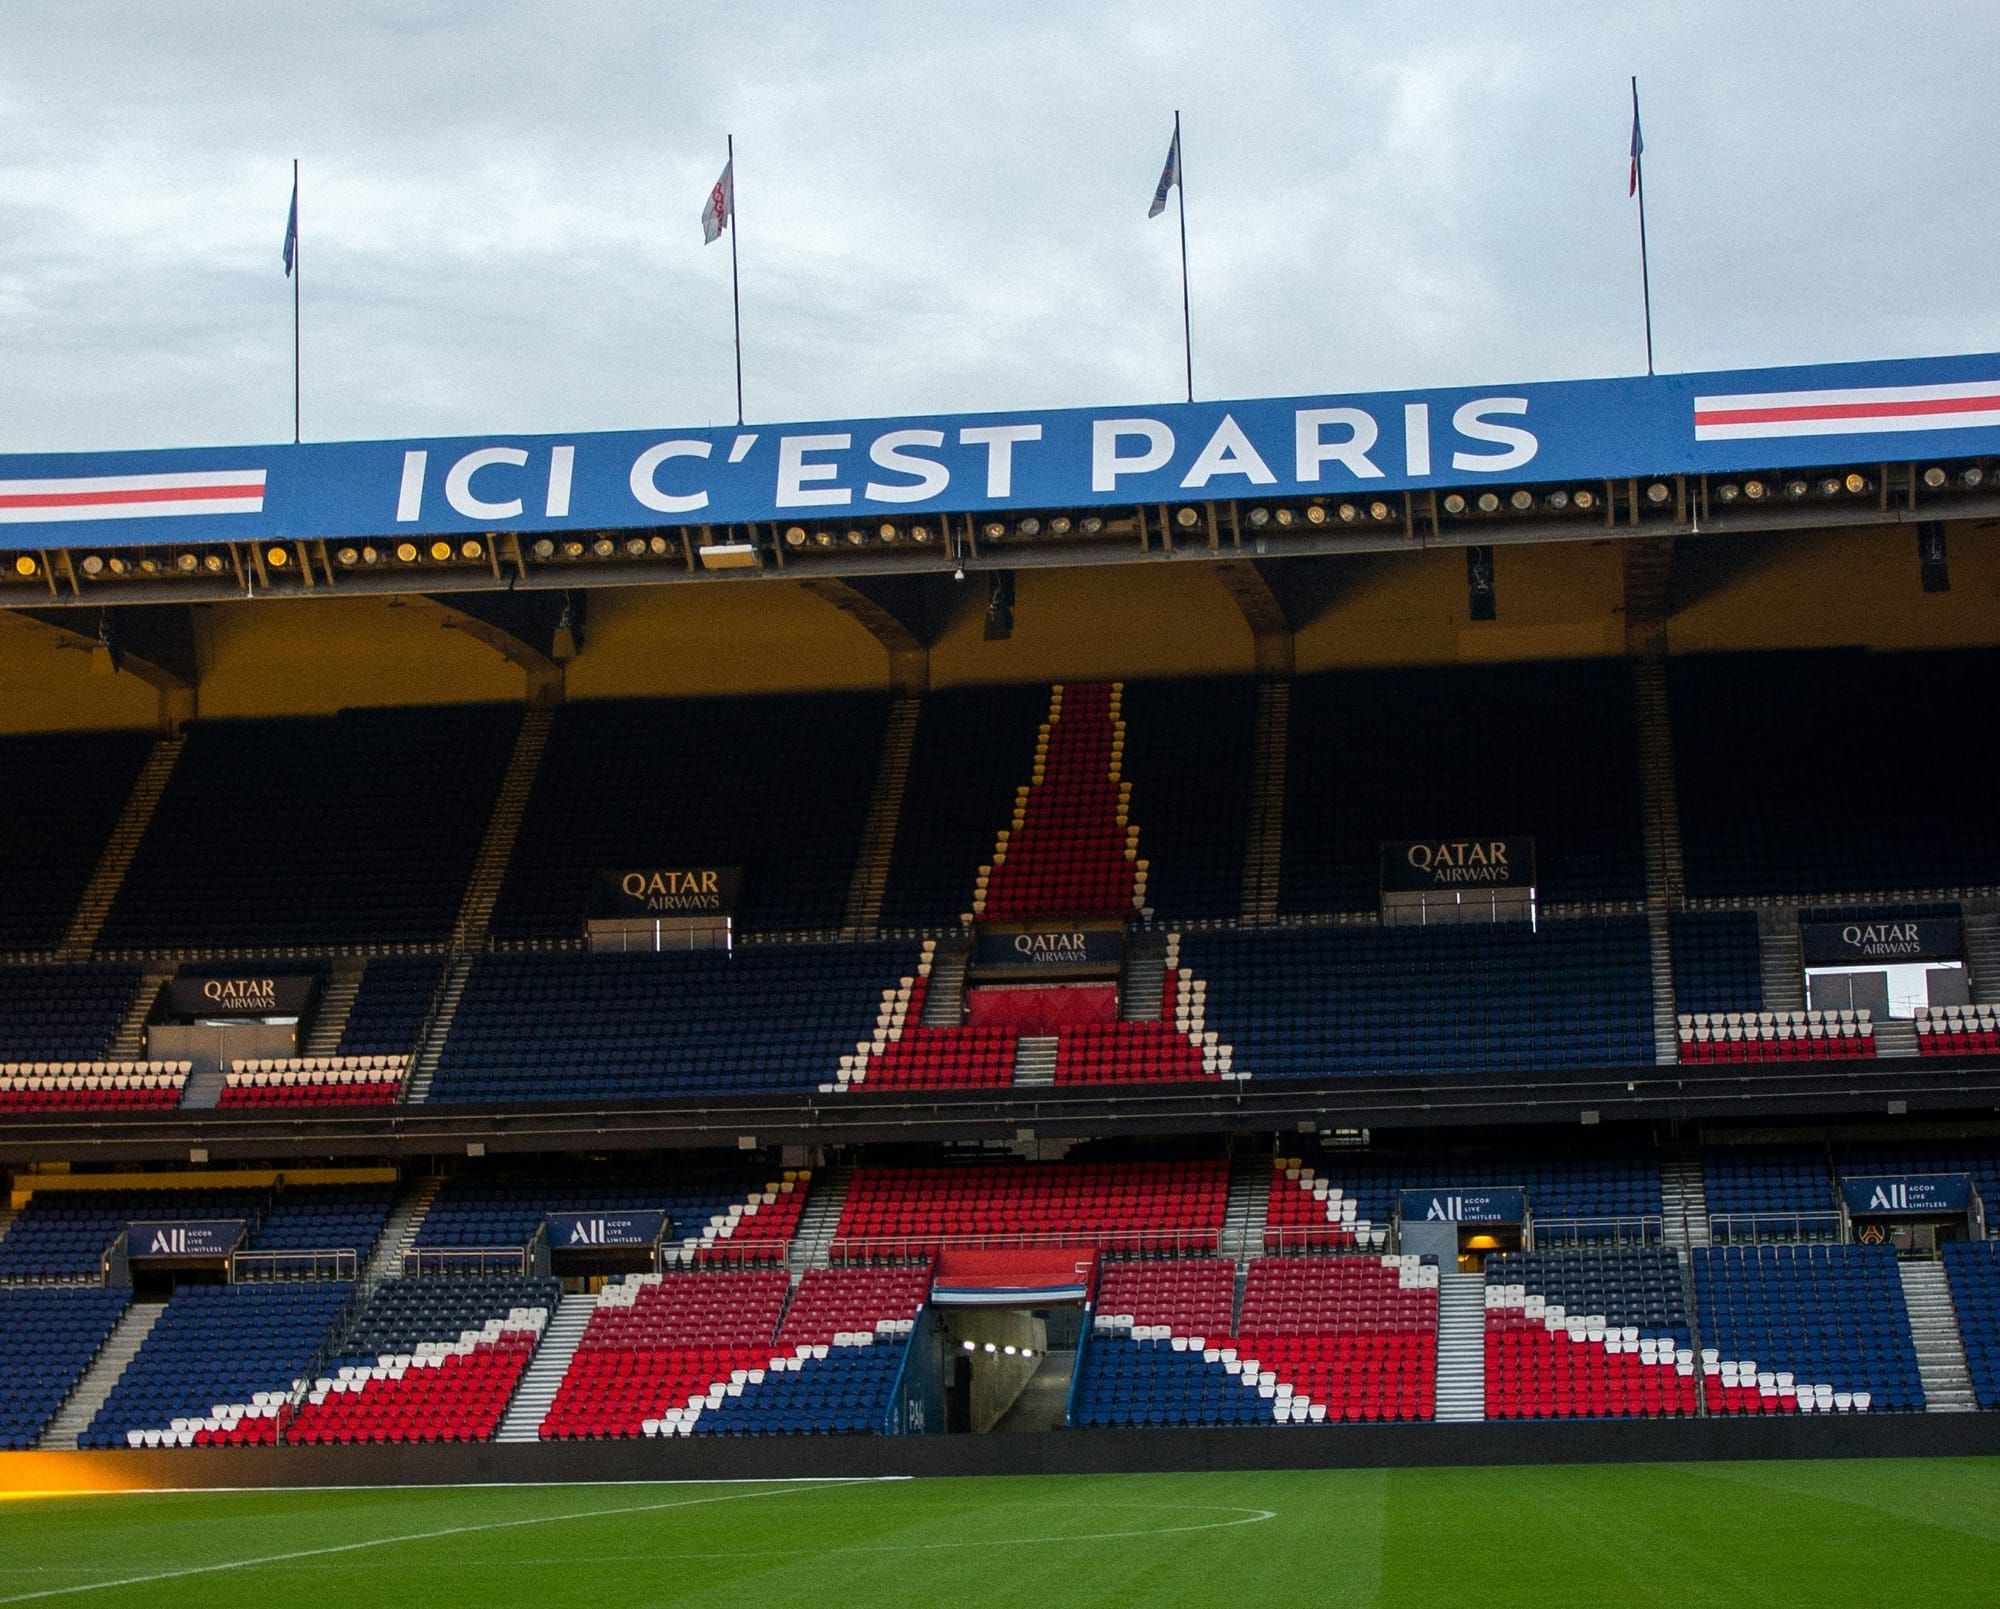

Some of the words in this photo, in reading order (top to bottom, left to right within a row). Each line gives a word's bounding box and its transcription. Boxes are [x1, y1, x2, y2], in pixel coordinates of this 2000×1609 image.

[397, 446, 575, 522] ICI
[630, 424, 1042, 513] C'EST
[1092, 397, 1538, 492] PARIS
[1407, 842, 1509, 872] QATAR
[1434, 866, 1510, 882] AIRWAYS
[622, 871, 719, 900] QATAR
[647, 894, 720, 910] AIRWAYS
[1014, 933, 1086, 955] QATAR
[1842, 923, 1919, 947] QATAR
[1033, 950, 1087, 962] AIRWAYS
[1863, 942, 1920, 954] AIRWAYS
[204, 980, 275, 1001] QATAR
[222, 997, 276, 1009] AIRWAYS
